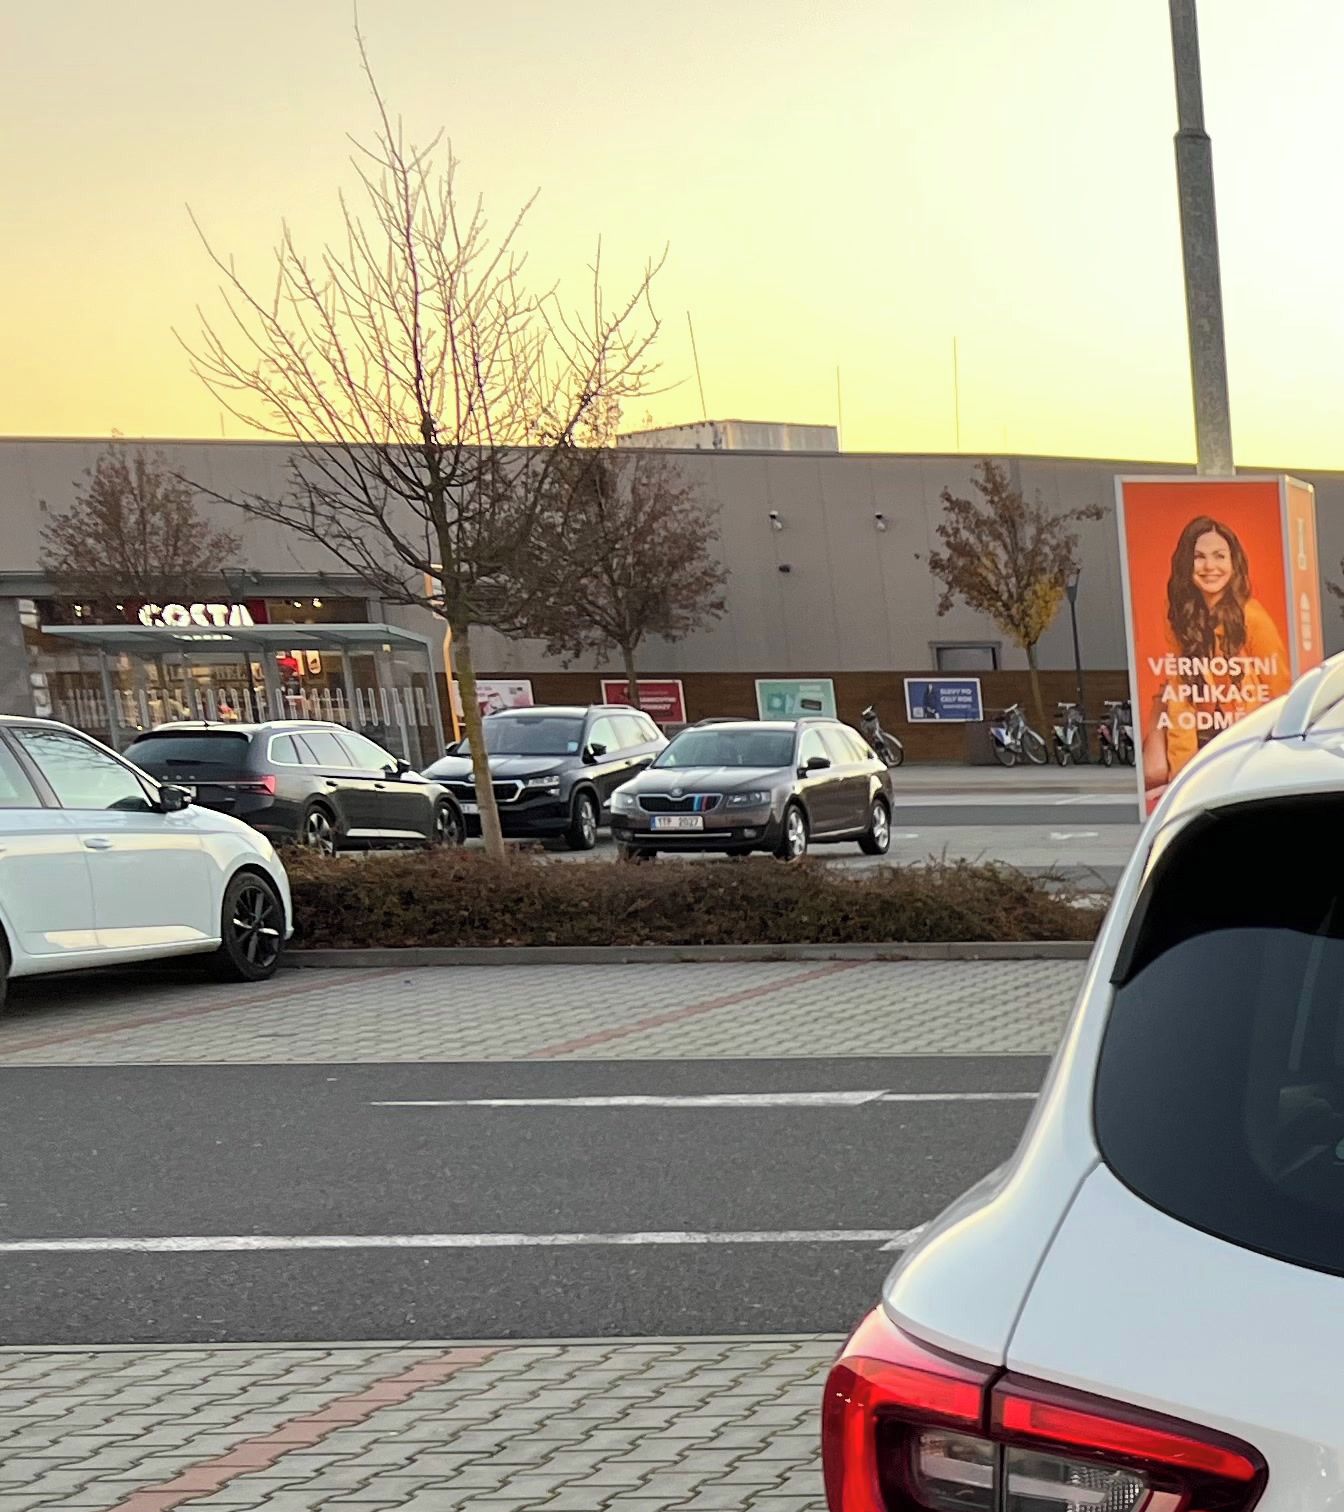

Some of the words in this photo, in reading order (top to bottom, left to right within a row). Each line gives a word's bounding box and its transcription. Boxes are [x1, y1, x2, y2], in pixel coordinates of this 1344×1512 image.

[138, 603, 254, 627] COSTA
[1148, 652, 1278, 676] VĚRNOSTNÍ
[1161, 684, 1270, 703] APLIKACE
[1156, 711, 1173, 730] A
